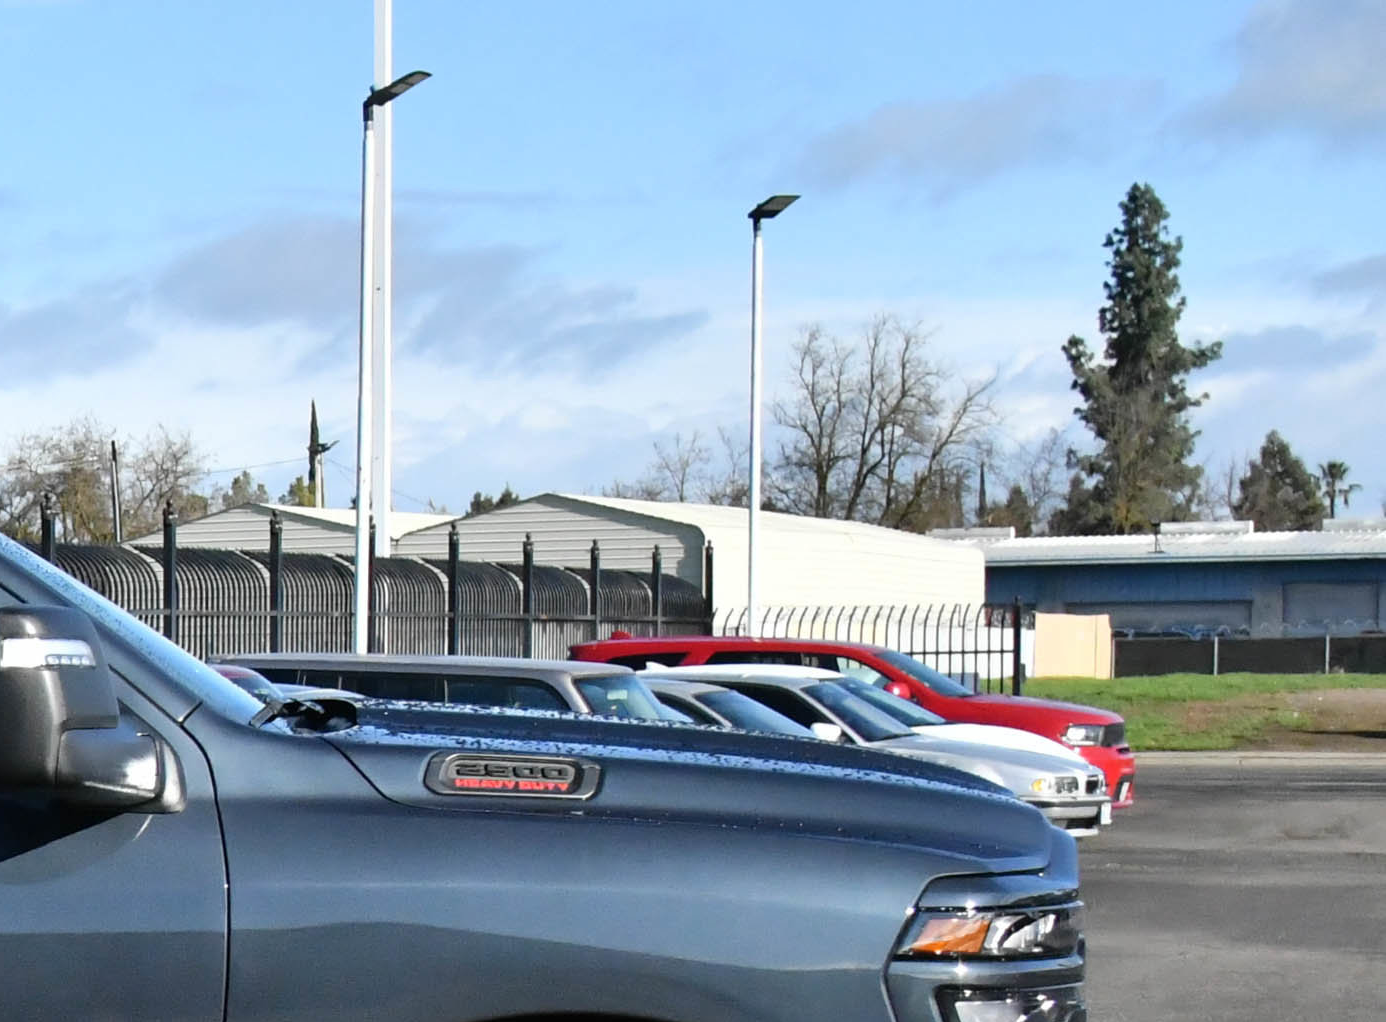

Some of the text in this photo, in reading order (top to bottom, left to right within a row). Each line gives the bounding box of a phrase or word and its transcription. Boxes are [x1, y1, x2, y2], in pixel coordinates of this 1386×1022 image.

[454, 762, 566, 780] 2500
[454, 777, 570, 791] HEAVY DUTY
